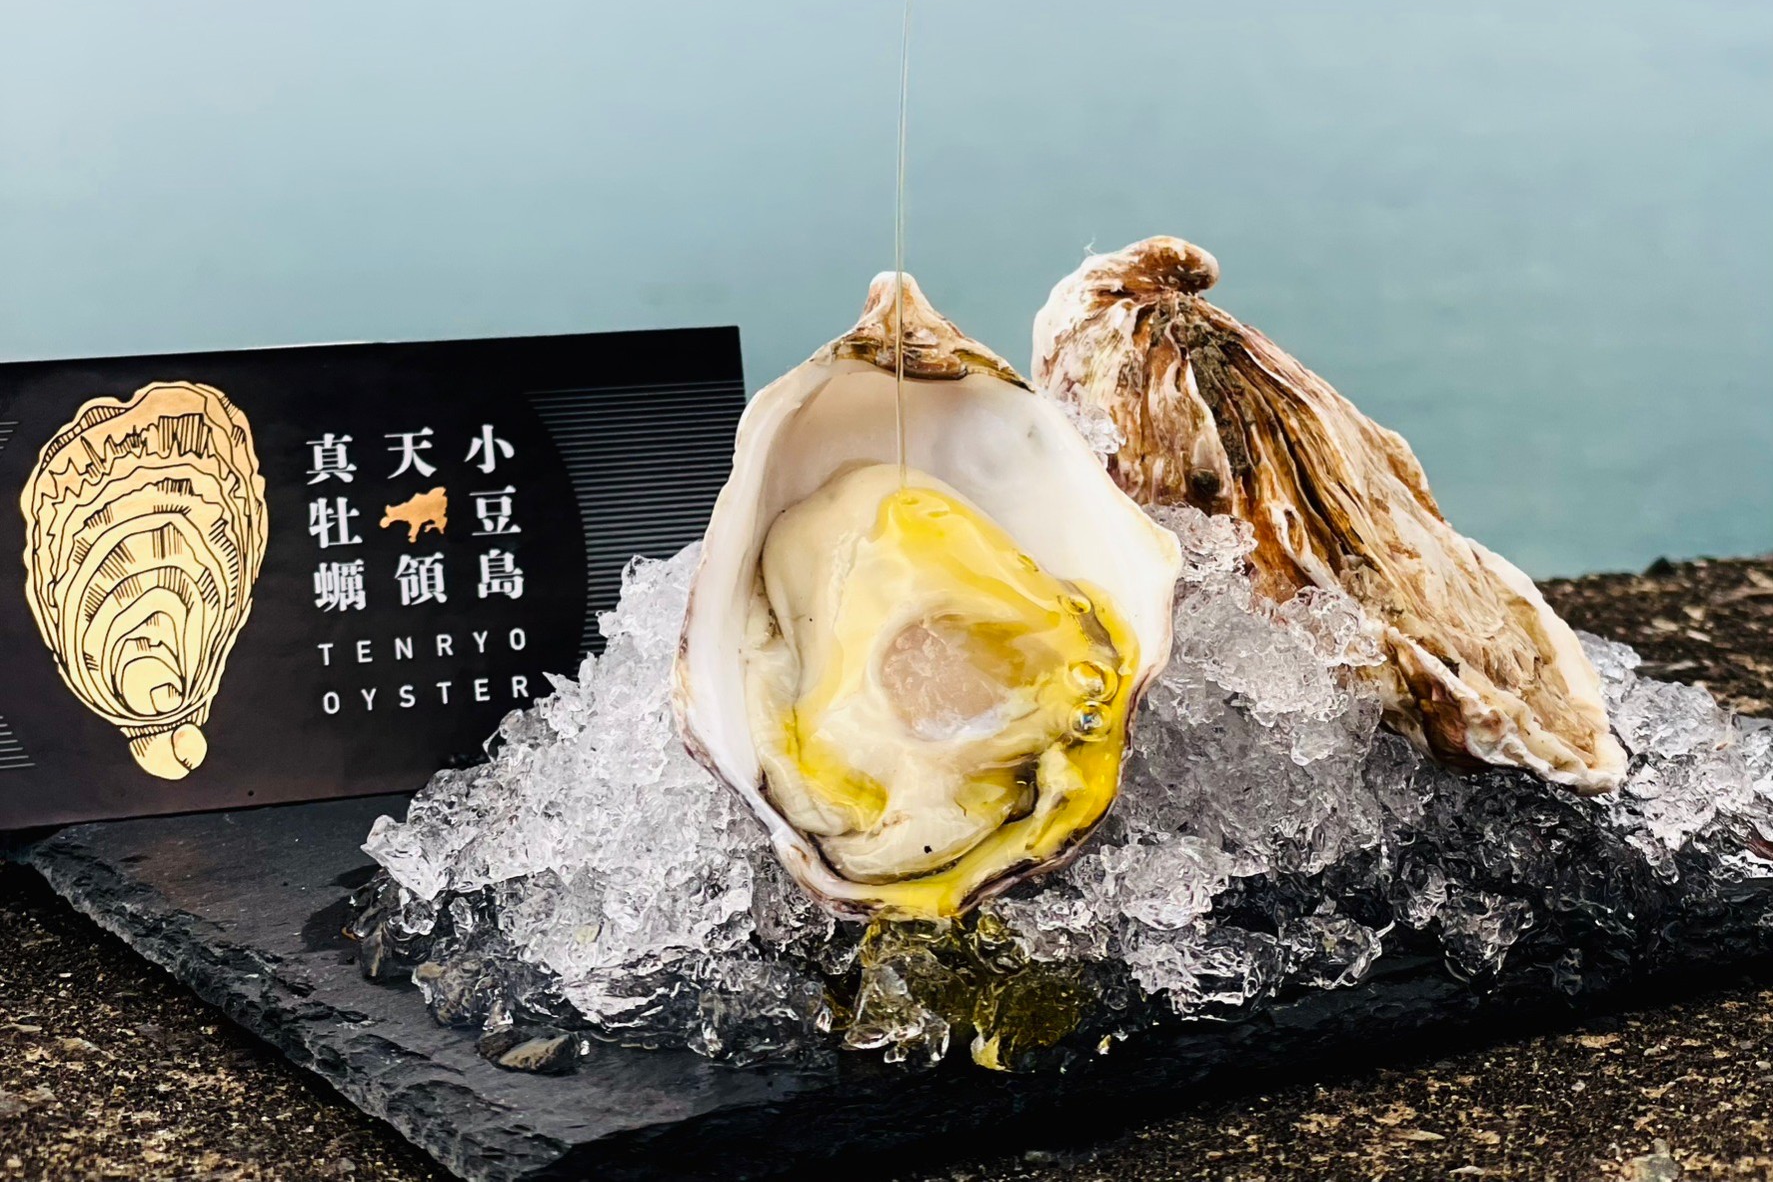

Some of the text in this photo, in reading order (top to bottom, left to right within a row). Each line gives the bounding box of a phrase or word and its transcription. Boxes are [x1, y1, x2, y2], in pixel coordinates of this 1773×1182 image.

[305, 433, 367, 612] 真牡蠣
[384, 426, 448, 606] 天領
[464, 423, 524, 600] 小豆島
[317, 627, 527, 666] TENRYO
[322, 674, 530, 715] OYSTER
